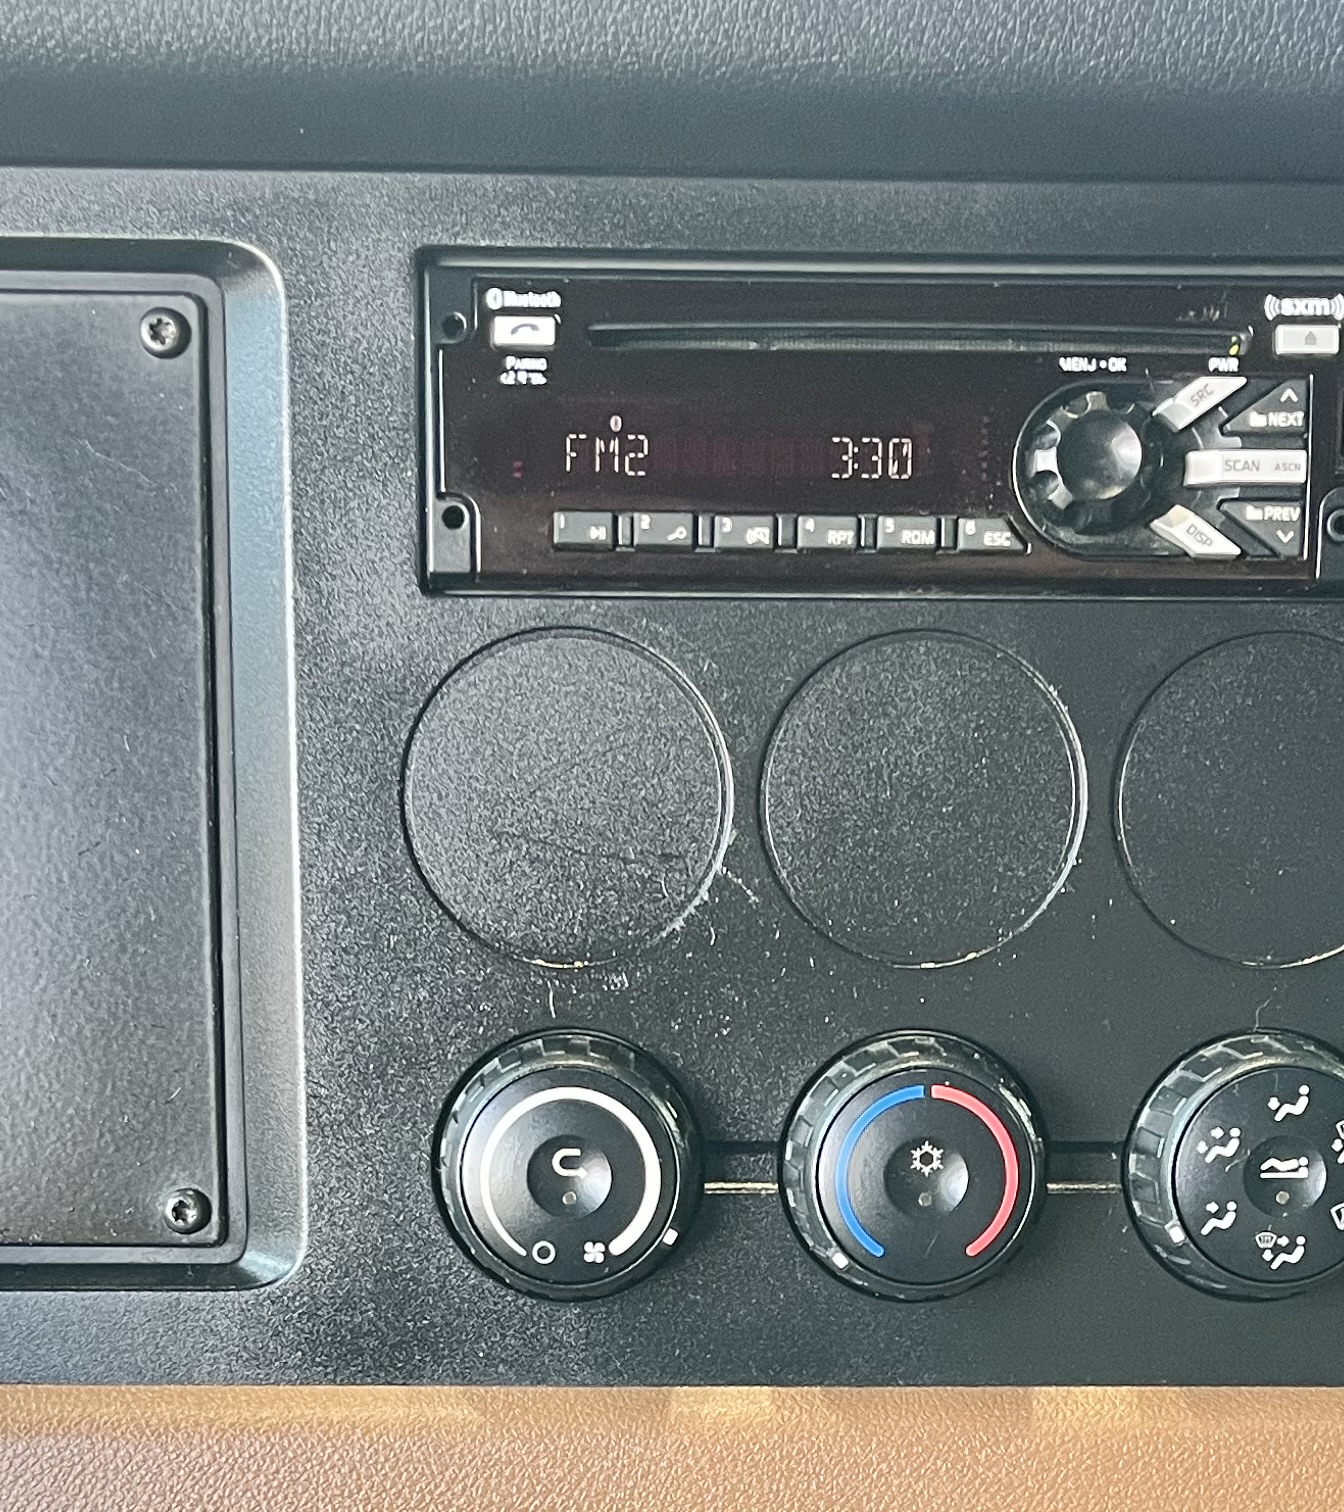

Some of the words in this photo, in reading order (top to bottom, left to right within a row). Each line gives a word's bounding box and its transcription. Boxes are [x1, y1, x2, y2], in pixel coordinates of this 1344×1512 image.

[1108, 357, 1127, 372] OK
[1208, 357, 1239, 373] PWR
[1190, 384, 1215, 408] SRC
[1268, 411, 1305, 427] NEXT
[565, 433, 649, 477] FM2
[830, 437, 914, 481] 3:30
[1224, 459, 1261, 473] SCAN
[1273, 462, 1302, 472] ASCN
[1263, 505, 1301, 522] PREV
[640, 515, 652, 530] 2
[721, 517, 733, 534] 3
[805, 517, 816, 533] 4
[983, 531, 1012, 547] ESC
[1185, 523, 1214, 548] DISP
